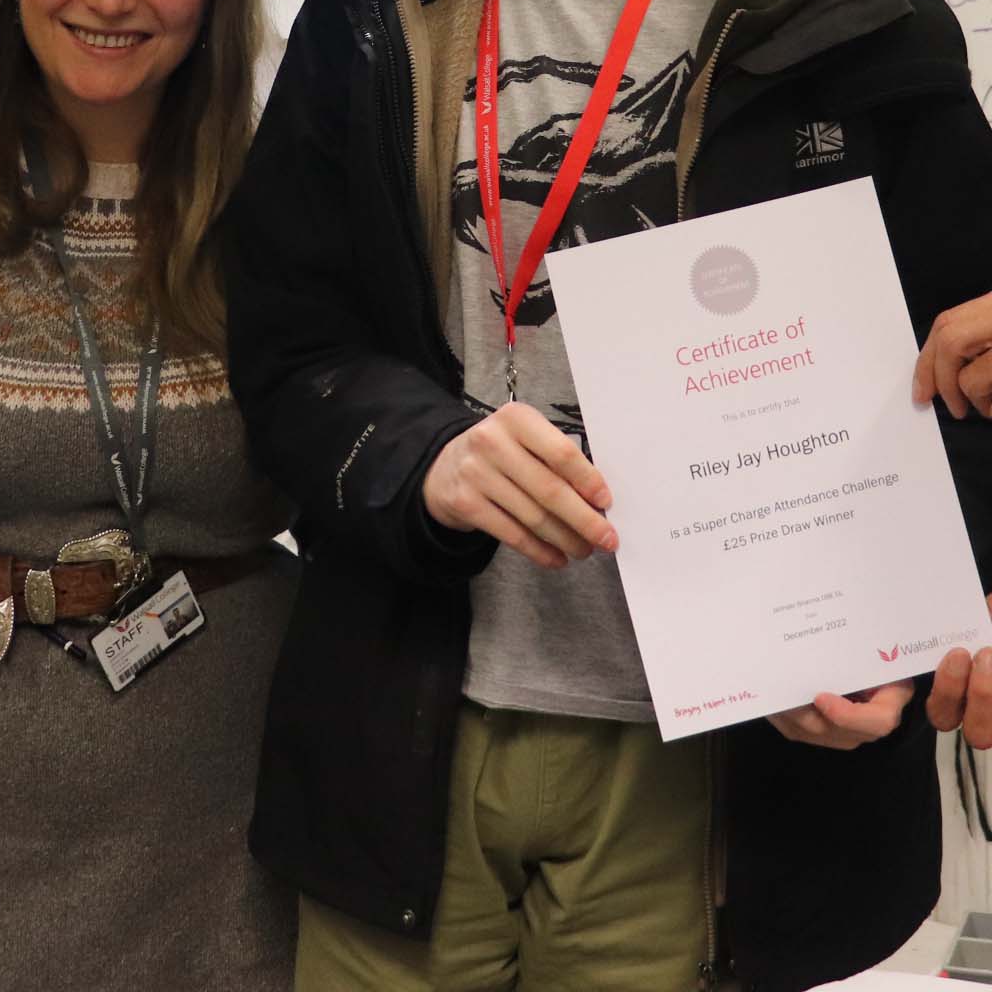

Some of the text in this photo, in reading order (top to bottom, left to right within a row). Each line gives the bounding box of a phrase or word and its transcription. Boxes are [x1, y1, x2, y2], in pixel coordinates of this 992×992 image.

[676, 316, 805, 366] Certificate of
[685, 348, 815, 395] Achievement
[721, 411, 738, 425] This
[758, 401, 782, 414] certify
[689, 428, 851, 481] Riley Jay Houghton
[670, 472, 900, 539] is a Super Charge Attendance Challenge
[723, 509, 856, 551] £25 Prize Draw Winner
[105, 621, 144, 658] STAFF
[784, 618, 848, 641] December 2022
[900, 636, 939, 655] Walsall
